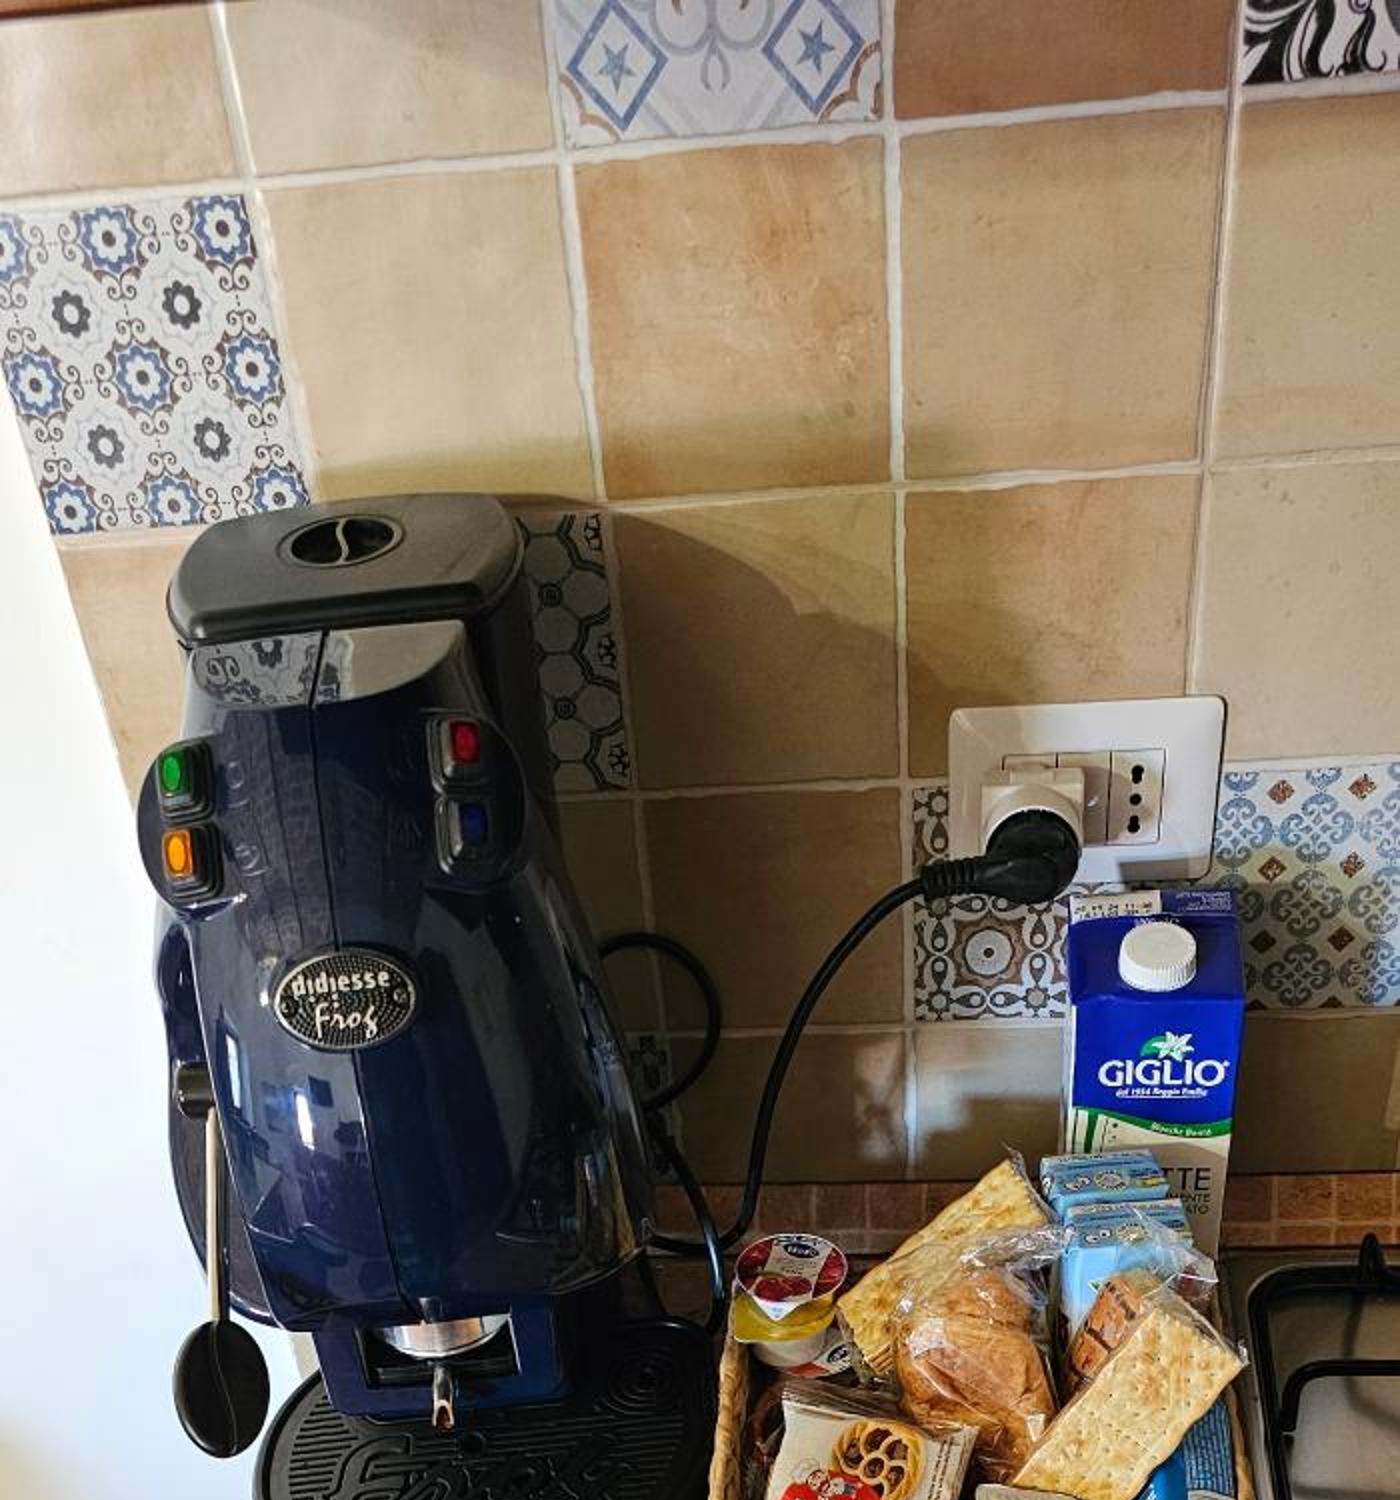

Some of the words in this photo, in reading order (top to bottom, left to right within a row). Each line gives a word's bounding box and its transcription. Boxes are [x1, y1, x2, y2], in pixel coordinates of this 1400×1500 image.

[290, 969, 392, 1001] didiesse
[314, 1001, 379, 1040] Frog
[1098, 1057, 1227, 1089] GIGLIO
